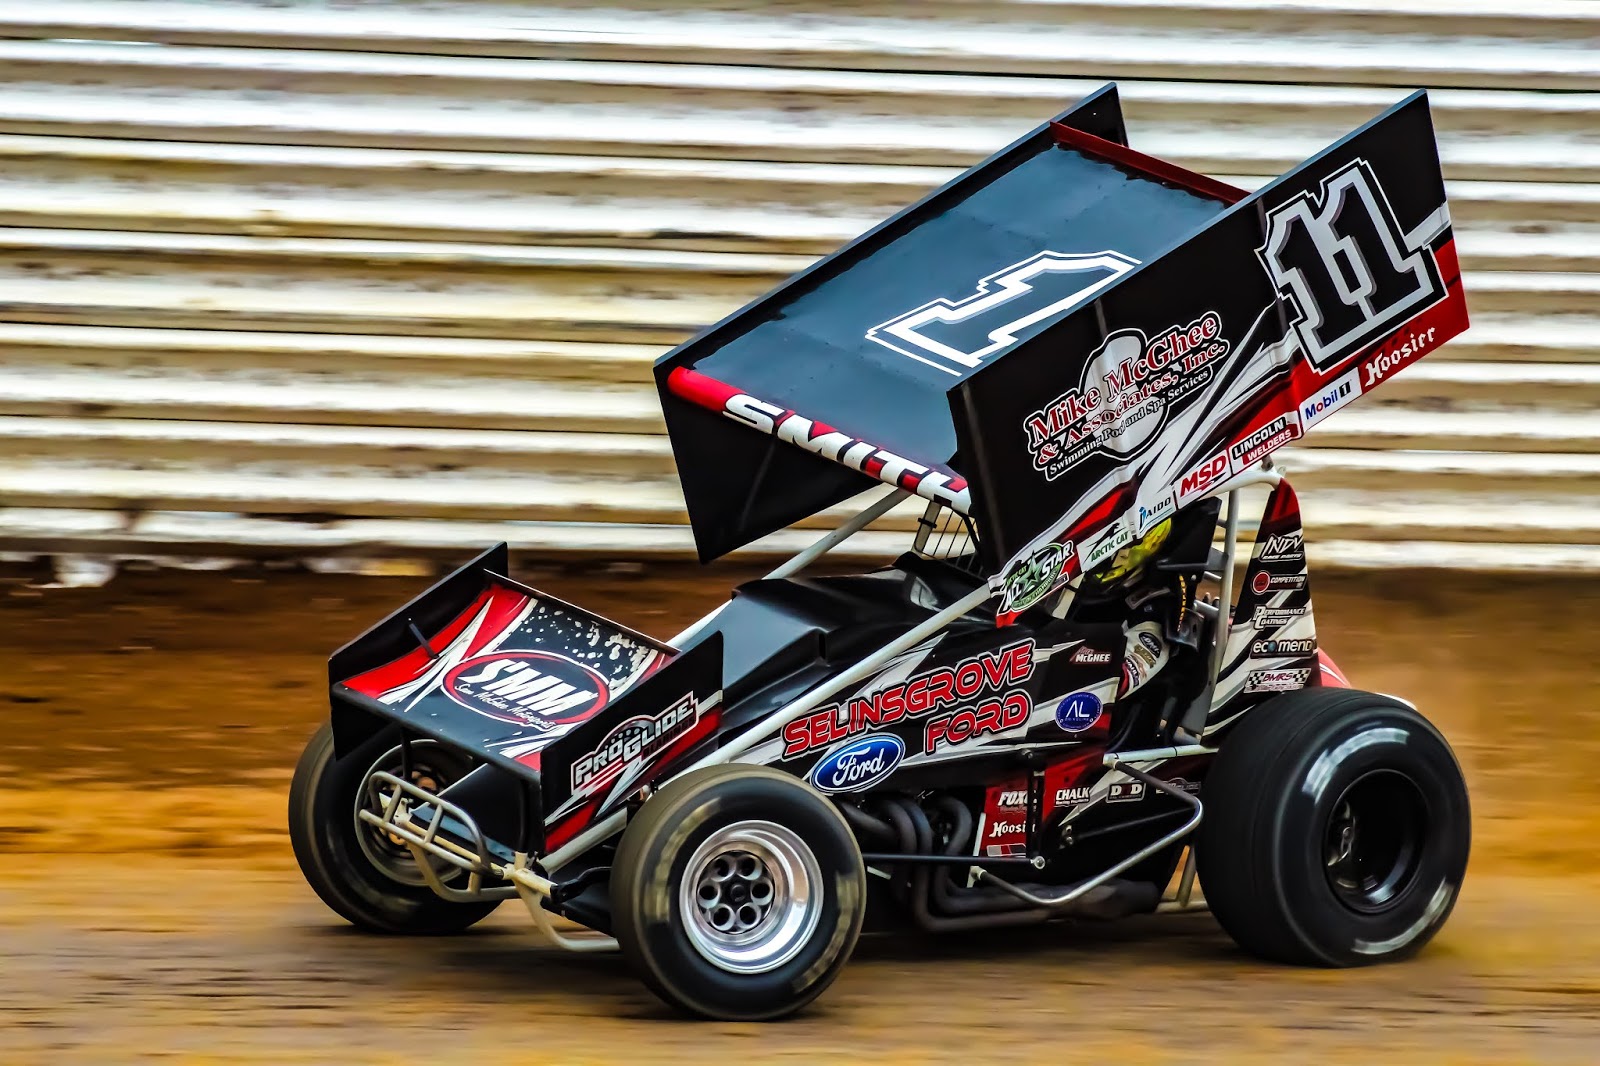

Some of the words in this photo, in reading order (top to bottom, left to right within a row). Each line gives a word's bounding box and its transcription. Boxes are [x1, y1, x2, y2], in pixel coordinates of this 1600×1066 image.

[1258, 160, 1442, 370] 11
[1365, 327, 1436, 387] Hoosier
[1029, 387, 1101, 448] Mike
[1105, 317, 1218, 402] McGhee
[1038, 443, 1058, 465] &
[1182, 342, 1226, 375] Inc.
[1050, 433, 1103, 475] Swimming
[1126, 408, 1146, 426] and
[1145, 398, 1166, 416] Spa
[1167, 370, 1208, 400] Services
[1305, 390, 1339, 421] Mobil
[1232, 417, 1286, 460] LINCOLN
[1249, 430, 1292, 462] WELDERS
[1180, 456, 1227, 497] MSD
[1041, 542, 1073, 580] STAR
[1090, 541, 1116, 563] ARCTIC
[1116, 531, 1129, 546] CAT
[1075, 653, 1111, 663] McGHEE
[456, 659, 599, 716] SMM
[783, 642, 1033, 757] SELINSGROVE
[925, 694, 1029, 753] FORD
[831, 745, 886, 786] Ford
[1055, 786, 1091, 801] CHALK
